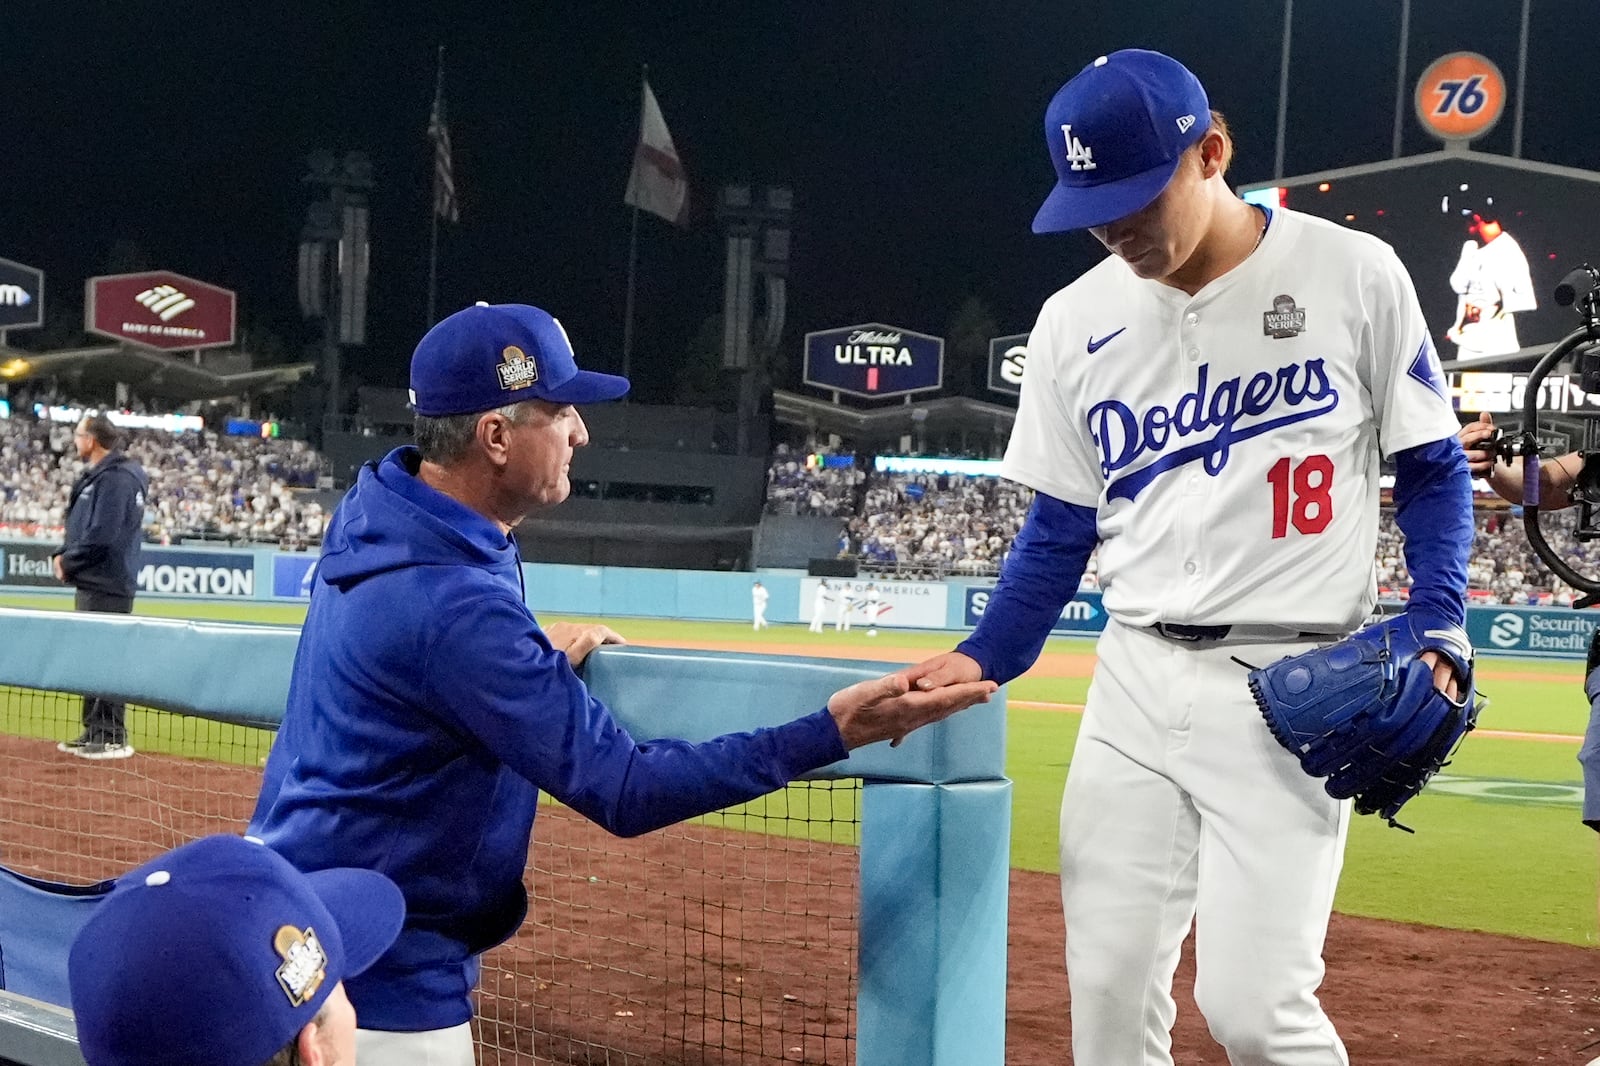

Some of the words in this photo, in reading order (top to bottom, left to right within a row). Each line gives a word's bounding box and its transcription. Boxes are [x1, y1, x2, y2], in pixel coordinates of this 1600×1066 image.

[1434, 76, 1487, 116] 76
[1061, 124, 1097, 171] LA
[1266, 312, 1304, 322] WORLD
[1268, 320, 1302, 329] SERIES
[122, 322, 148, 334] BANK
[163, 326, 205, 338] AMERICA
[835, 344, 913, 366] ULTRA
[499, 361, 534, 376] WORLD
[503, 368, 535, 384] SERIES
[1087, 358, 1338, 482] Dodgers
[1266, 454, 1336, 539] 18
[8, 553, 54, 576] Heal
[137, 564, 253, 595] MORTON
[1529, 615, 1596, 636] Security
[1529, 633, 1586, 649] Benefit
